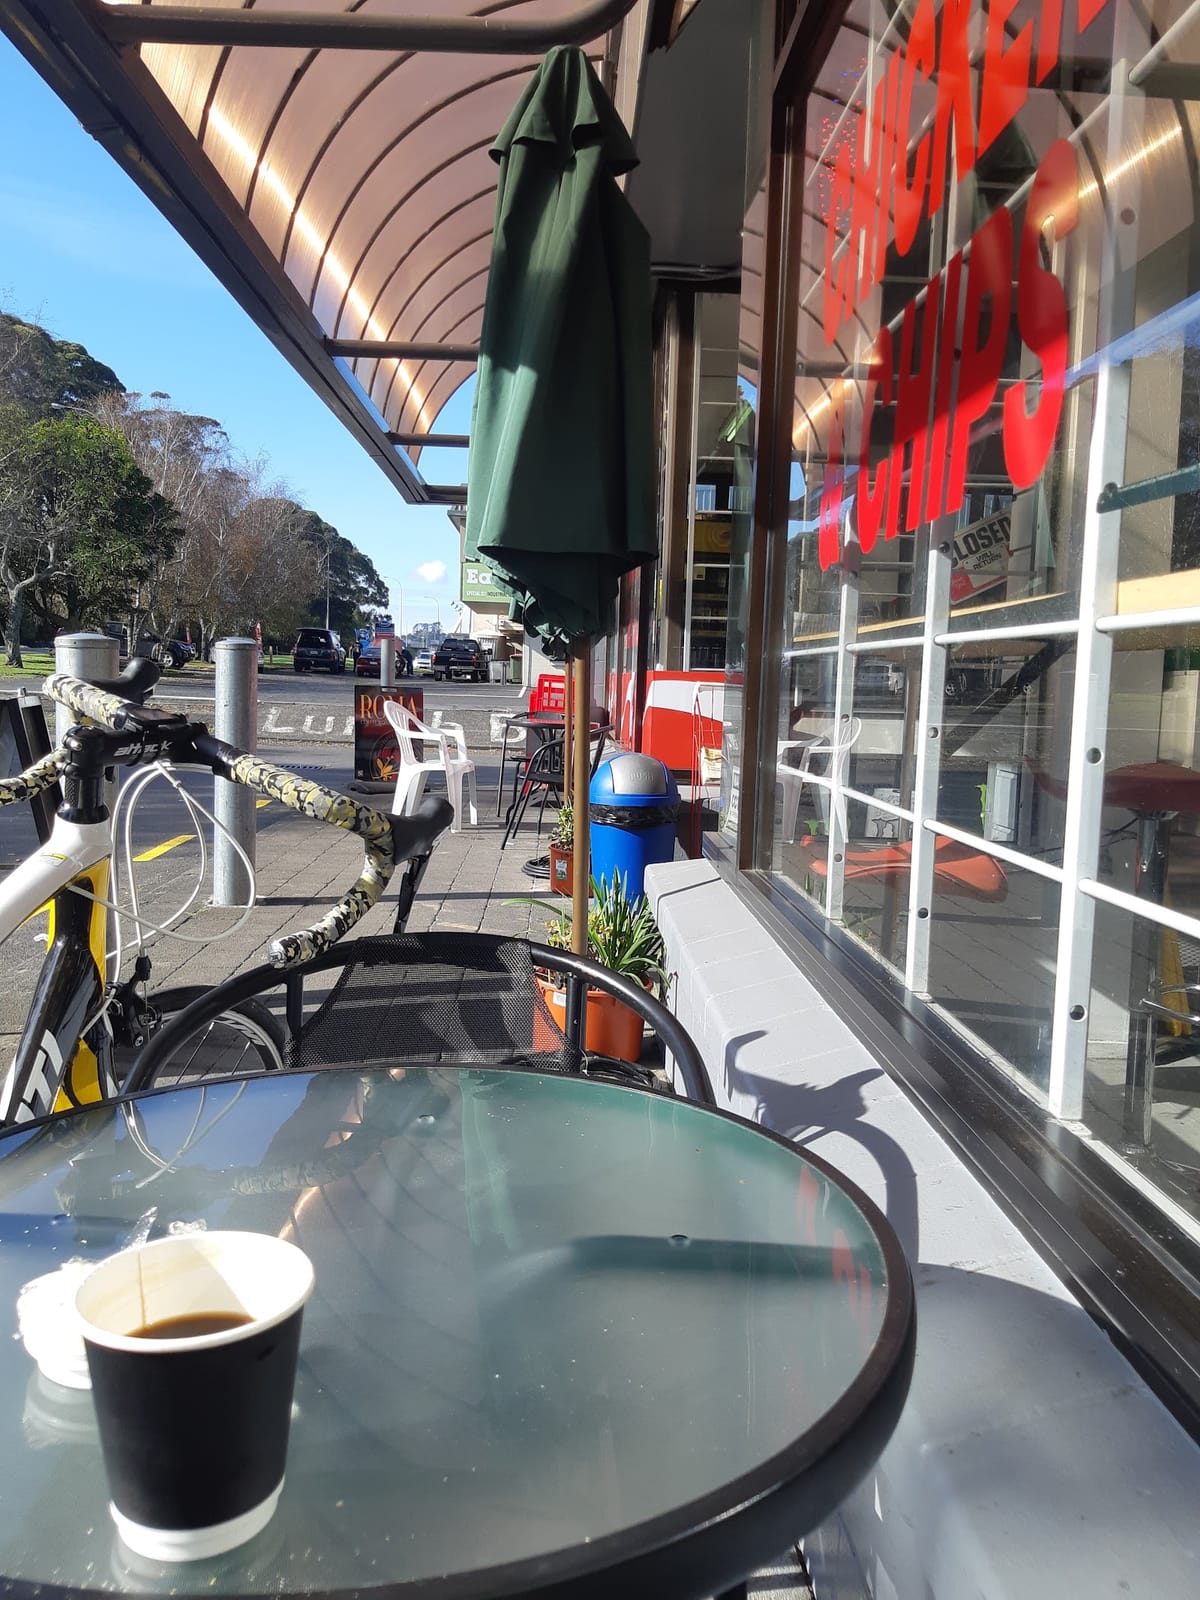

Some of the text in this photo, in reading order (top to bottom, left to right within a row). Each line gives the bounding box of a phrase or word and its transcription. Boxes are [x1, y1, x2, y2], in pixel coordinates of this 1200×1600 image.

[857, 138, 1078, 554] CHIPS
[951, 517, 1012, 569] LOSED
[975, 550, 994, 563] WILL
[973, 552, 1003, 570] RETURN
